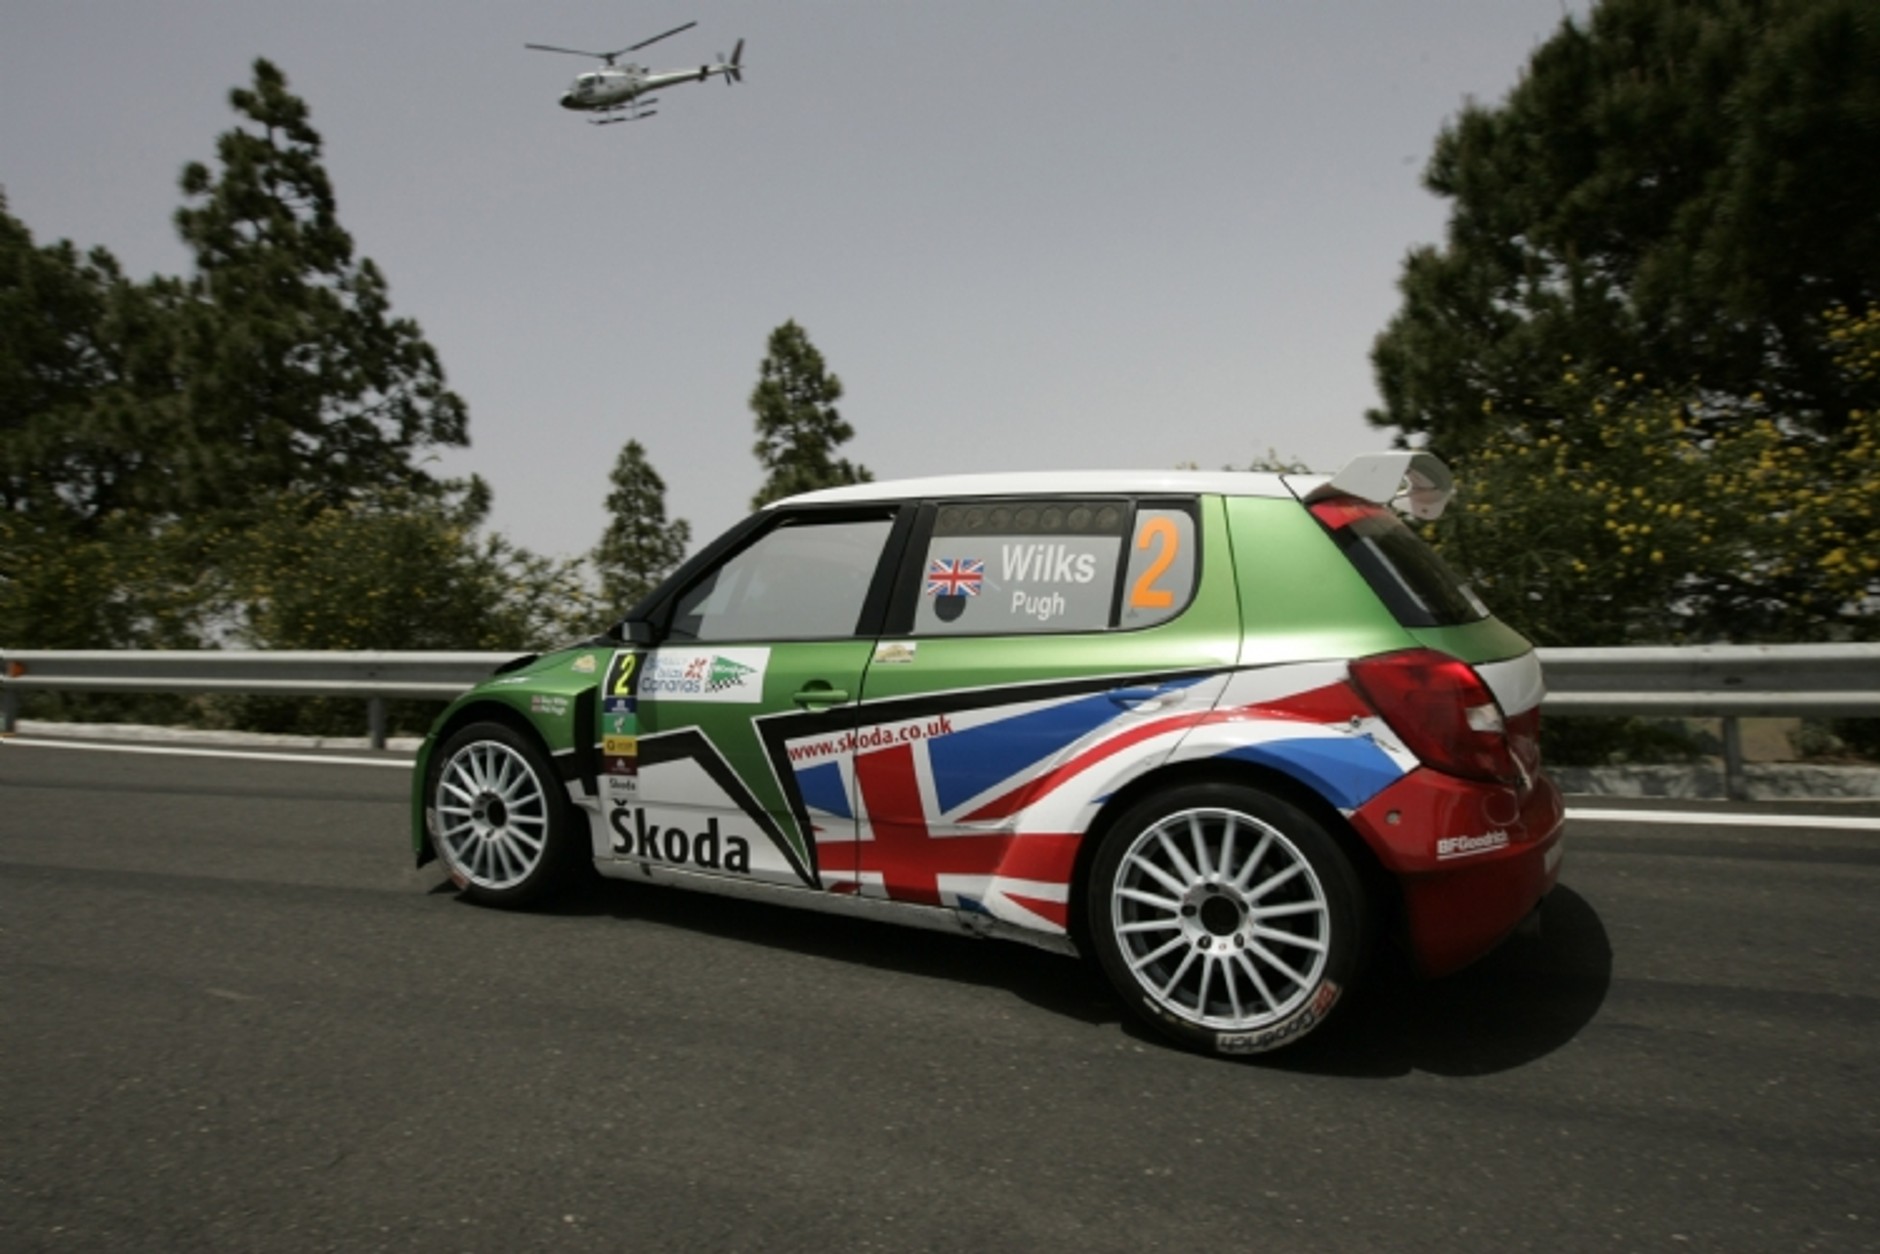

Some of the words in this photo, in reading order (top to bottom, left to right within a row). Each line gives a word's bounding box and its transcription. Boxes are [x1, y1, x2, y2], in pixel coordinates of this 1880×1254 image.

[1002, 544, 1097, 584] Wilks
[1129, 516, 1180, 608] 2
[1011, 591, 1066, 620] Pugh
[614, 653, 636, 695] 2
[641, 676, 701, 693] Canarias
[789, 712, 953, 761] www.skoda.co.uk
[609, 798, 750, 874] Škoda
